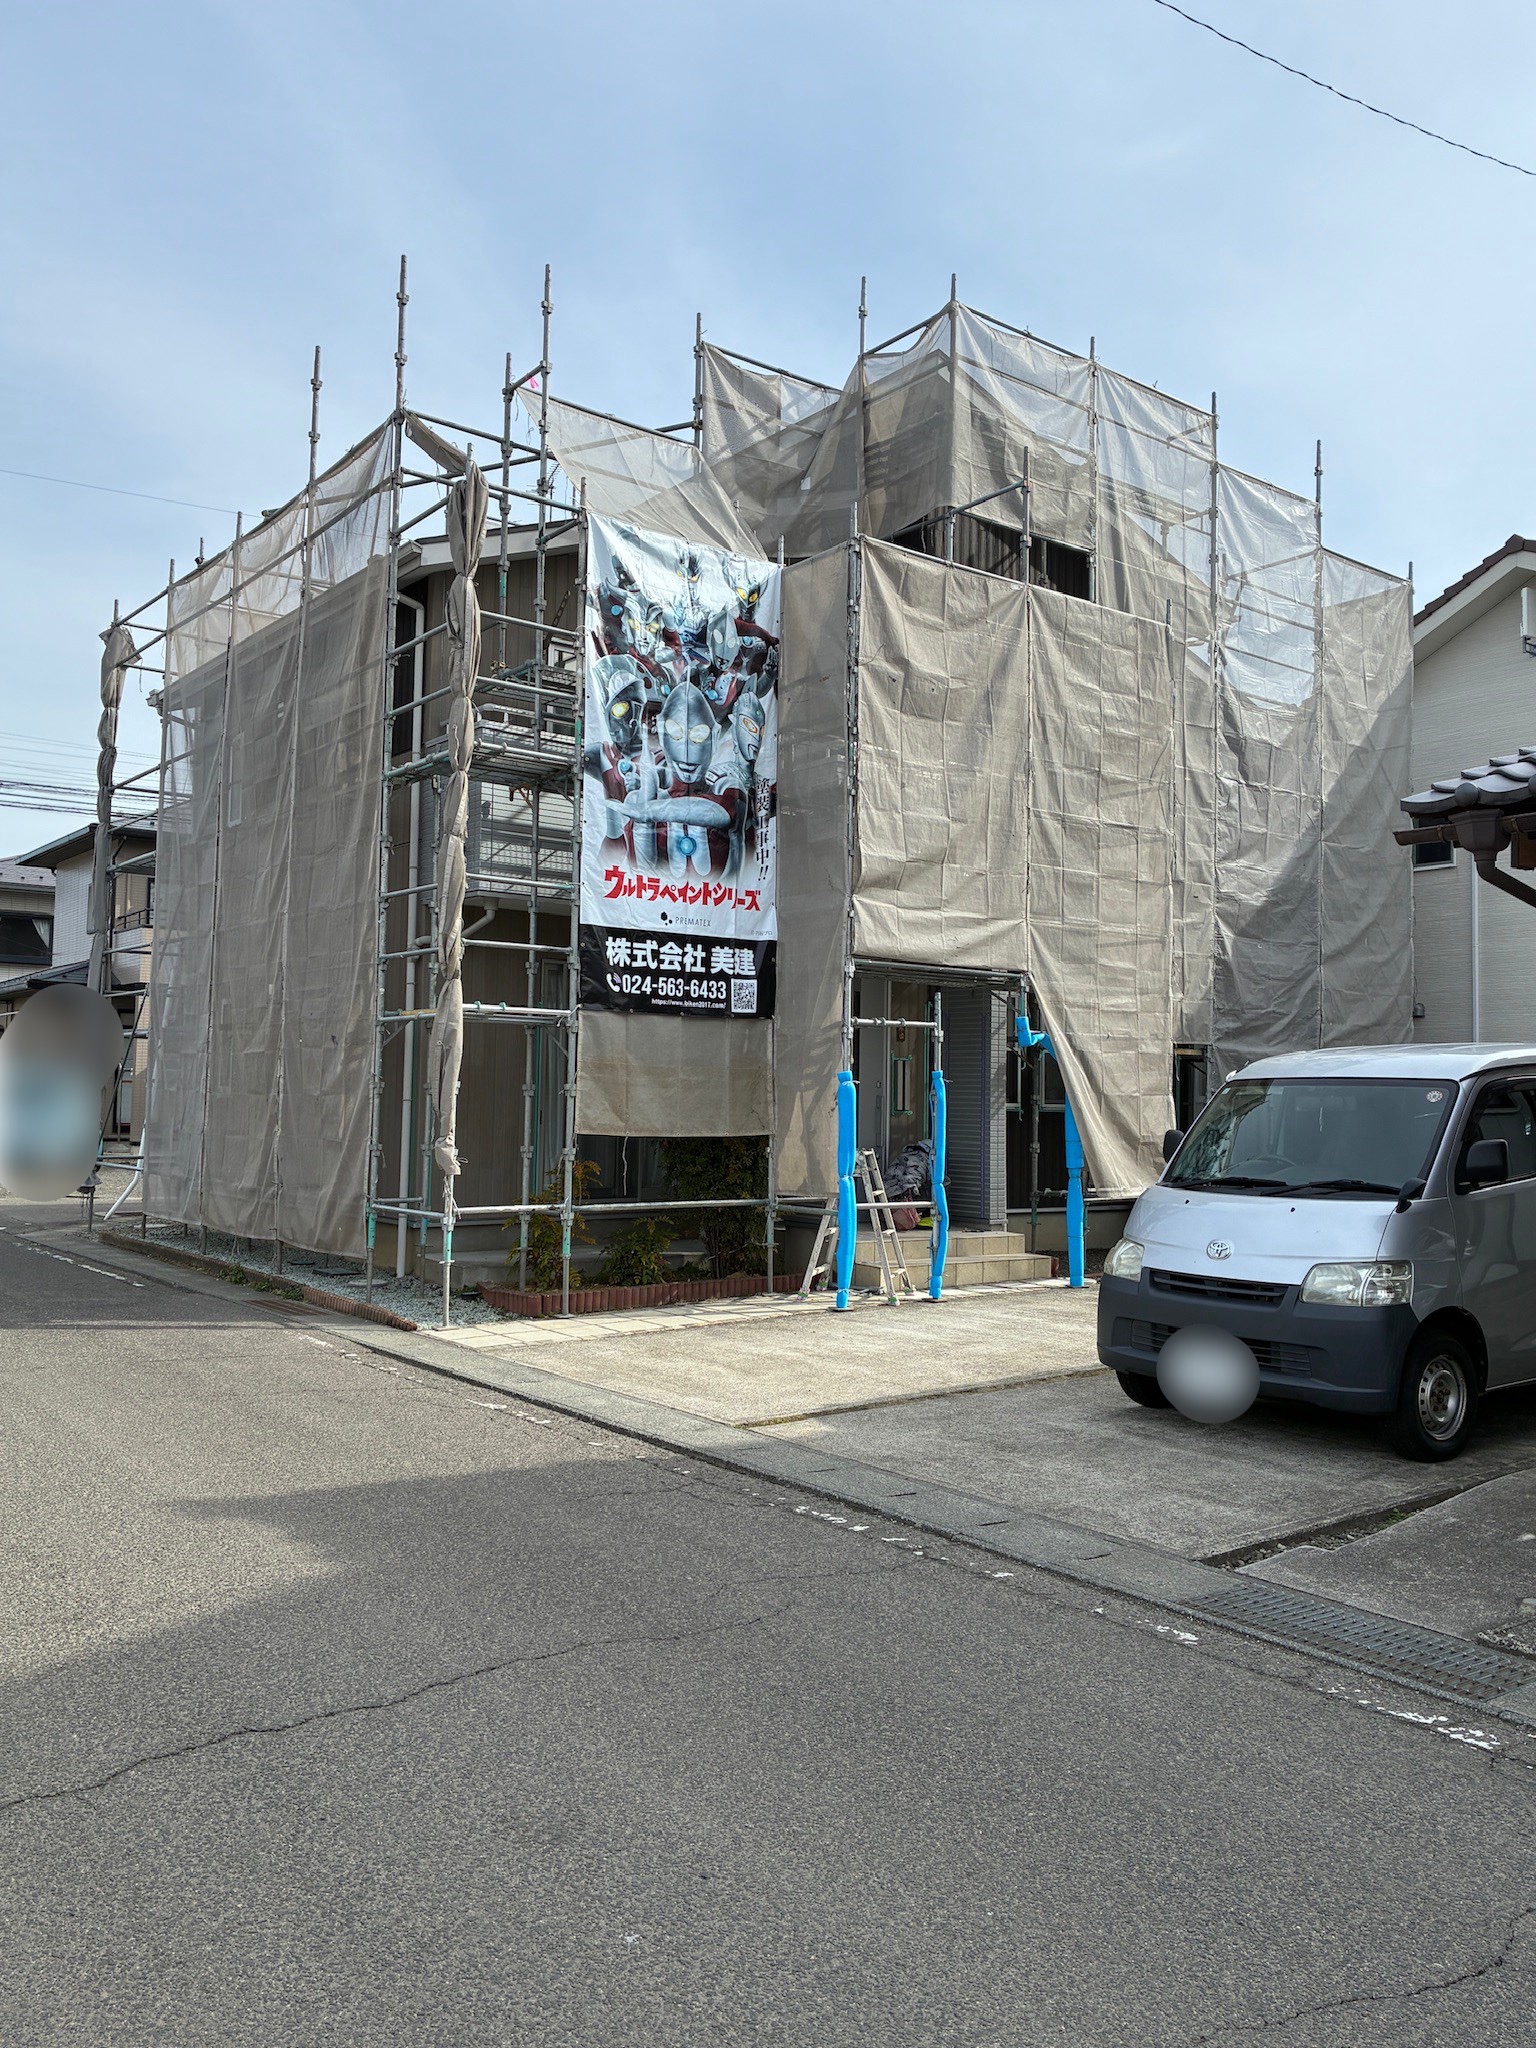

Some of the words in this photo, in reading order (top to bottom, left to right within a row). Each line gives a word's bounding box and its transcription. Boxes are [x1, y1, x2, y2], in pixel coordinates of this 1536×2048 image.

[604, 865, 761, 912] ウルトラペイントシリーズ
[675, 916, 711, 927] PREMATEX
[622, 974, 727, 999] 024-563-6433
